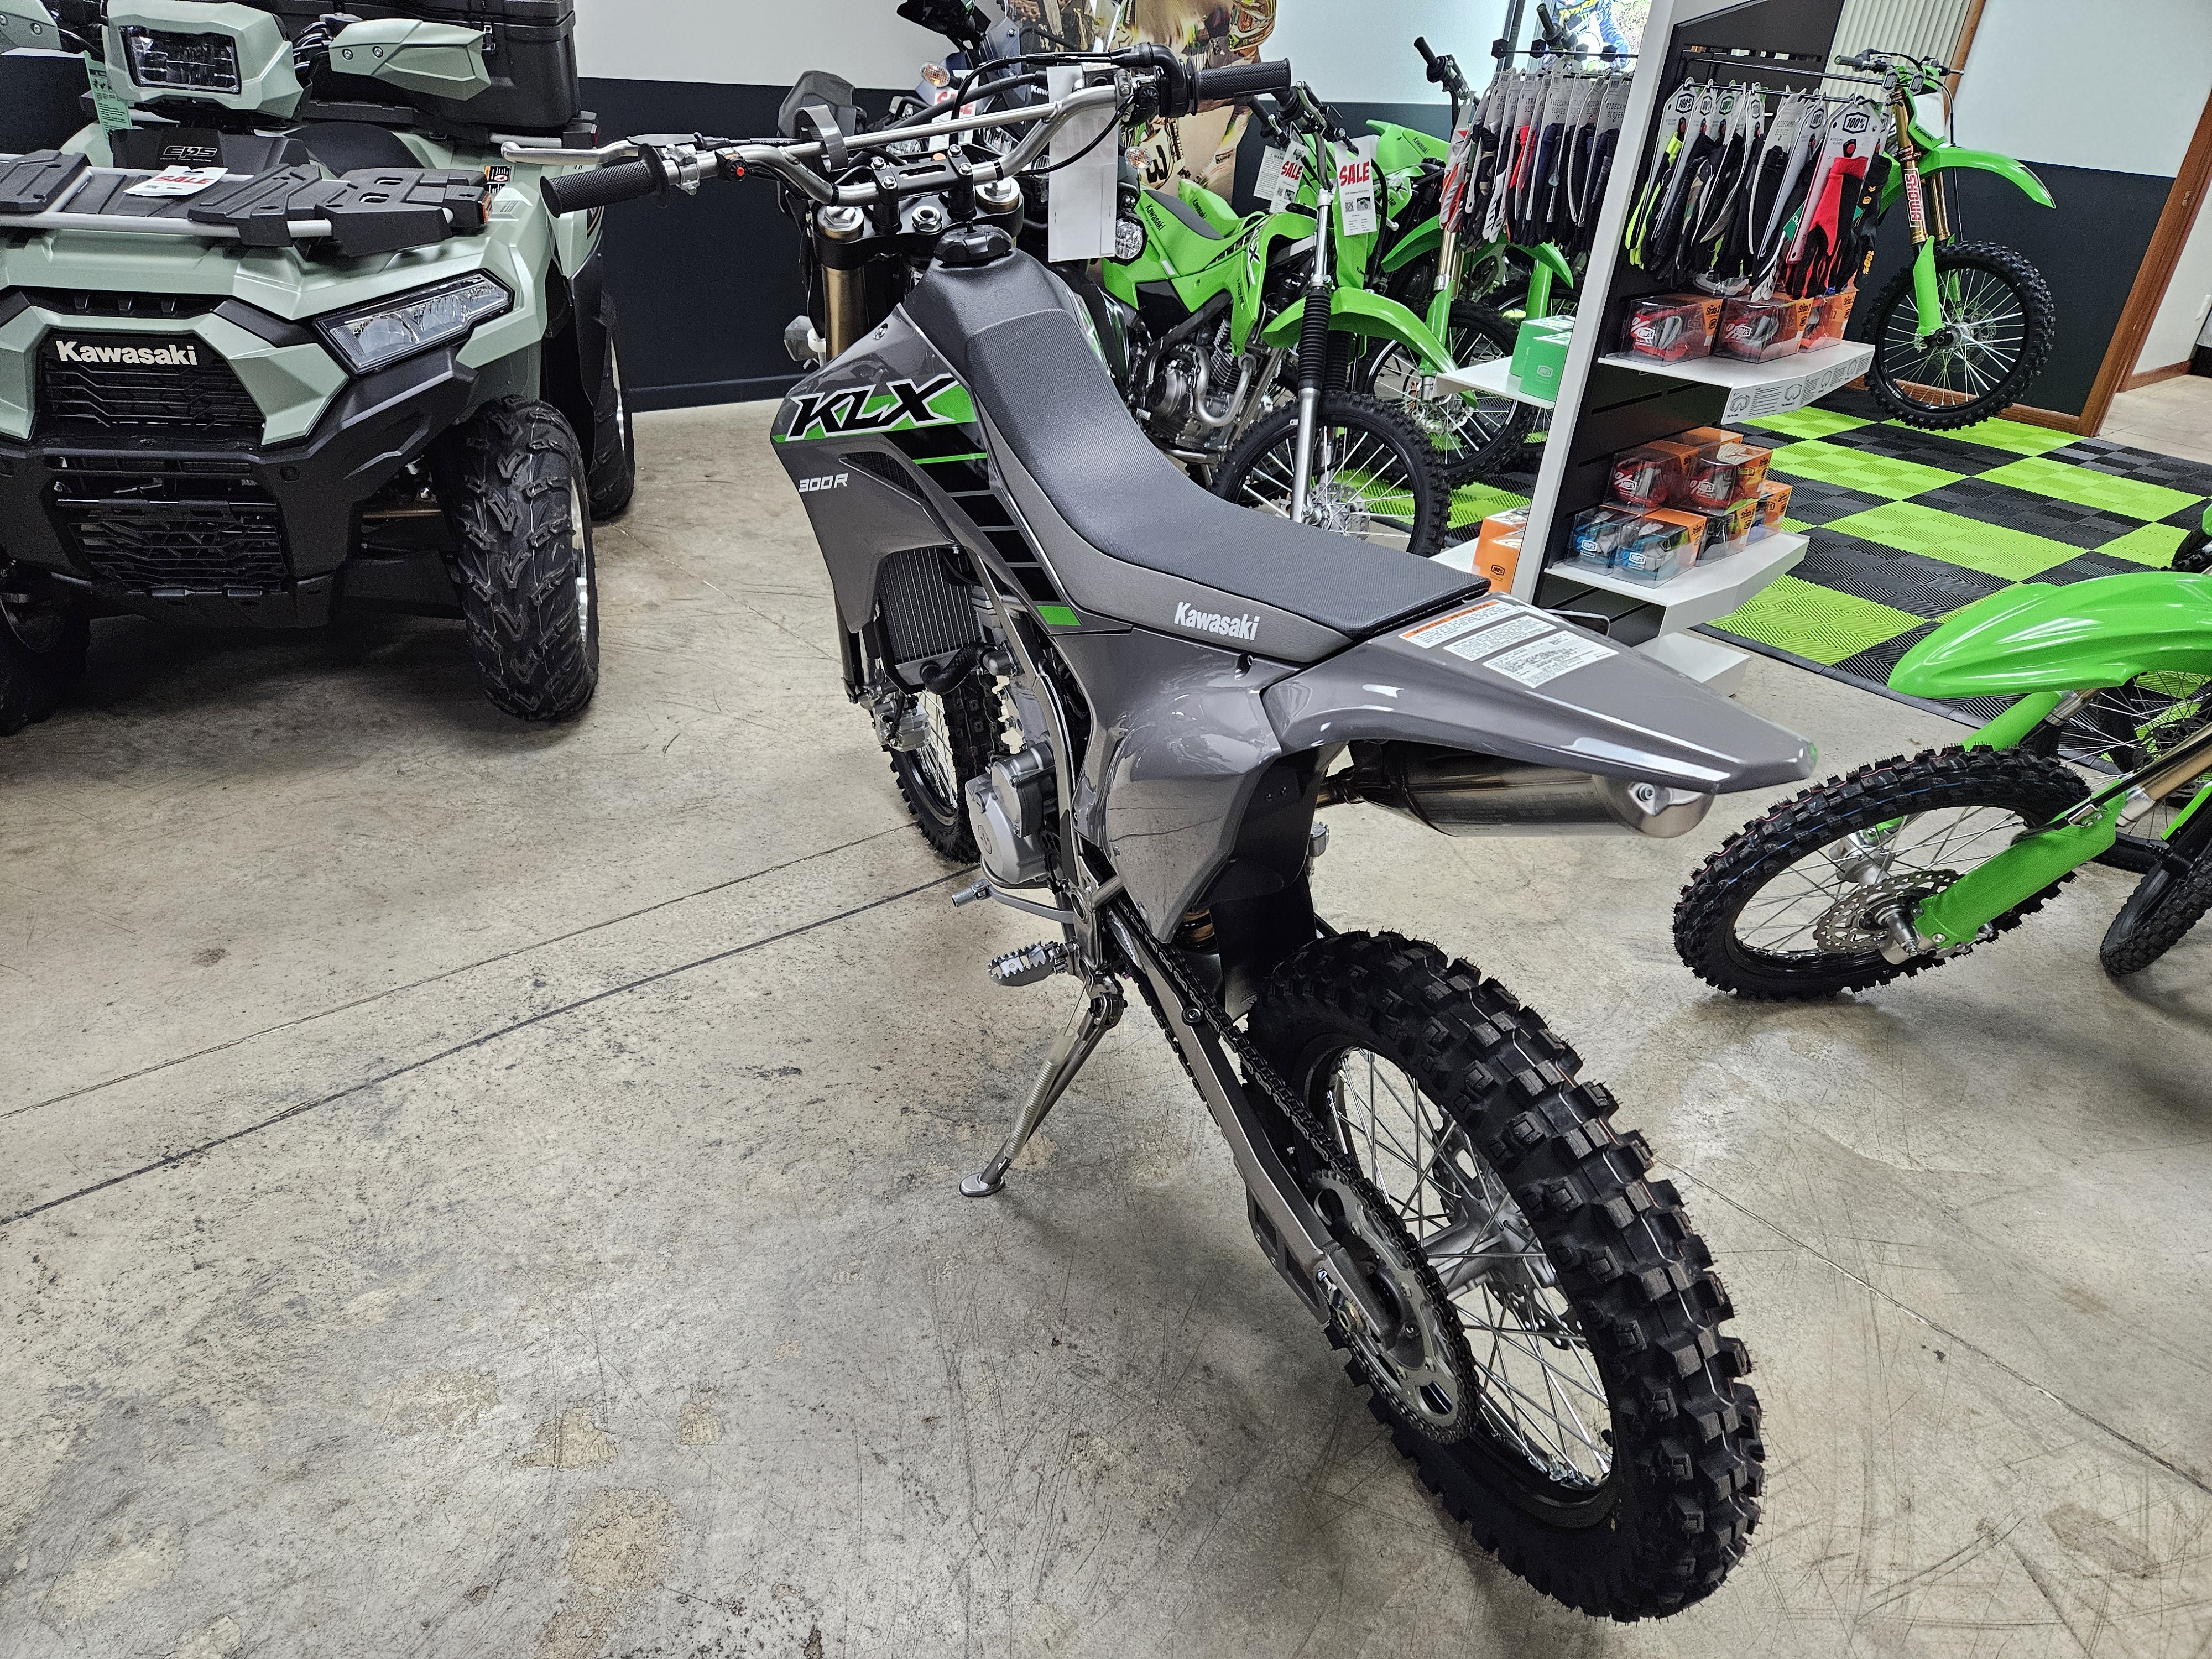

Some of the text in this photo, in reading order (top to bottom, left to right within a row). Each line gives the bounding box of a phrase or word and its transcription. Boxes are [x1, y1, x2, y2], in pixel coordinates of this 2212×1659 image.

[1678, 98, 1692, 109] 100%
[1846, 118, 1865, 129] 100%
[1914, 126, 1934, 142] Kawasaki
[1413, 137, 1430, 154] Kawasaki
[153, 175, 215, 185] SALE
[1281, 161, 1303, 180] SALE
[1339, 161, 1370, 187] SALE
[1905, 173, 1923, 222] SHOWA
[1145, 204, 1166, 231] Kawasaki
[1192, 198, 1208, 220] Kawasaki
[55, 340, 198, 366] Kawasaki
[785, 373, 959, 441] KLX
[799, 473, 848, 493] 300R
[1631, 554, 1644, 562] 100%
[1173, 601, 1261, 642] Kawasaki
